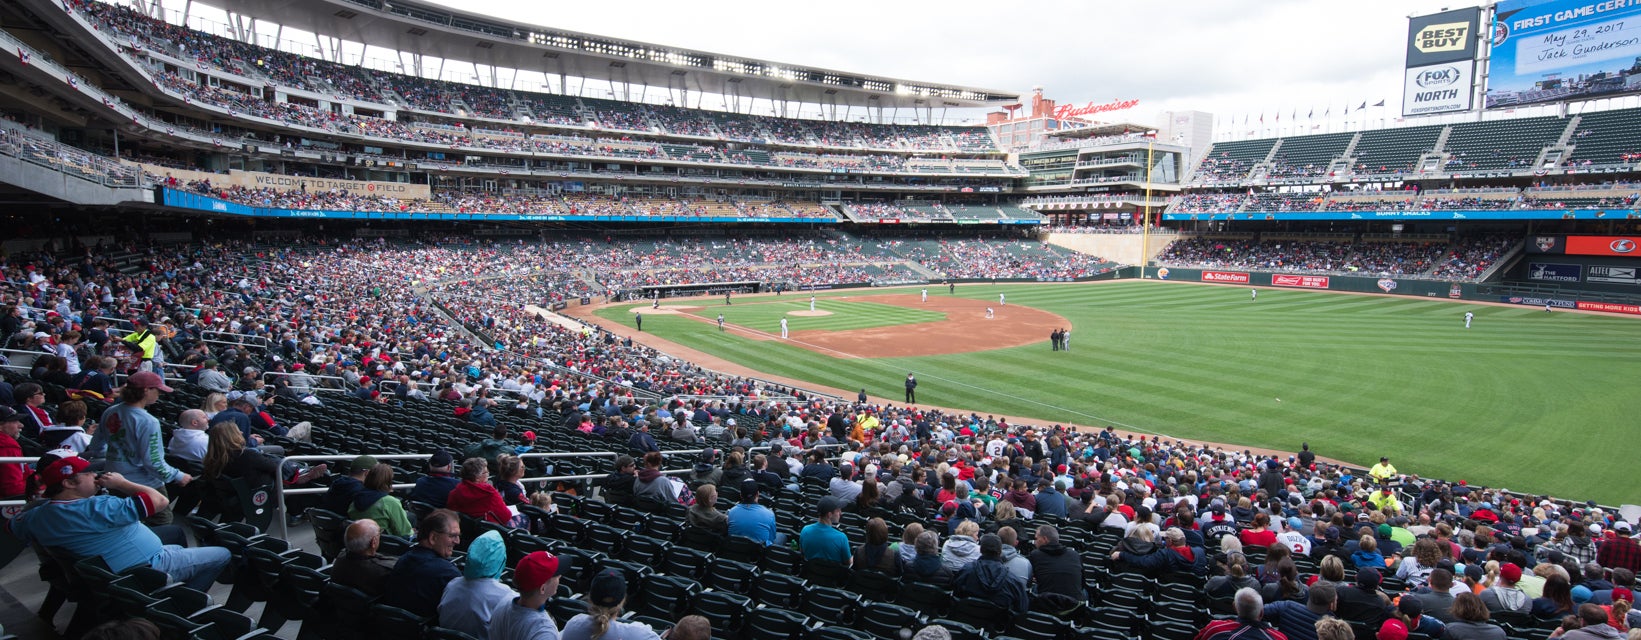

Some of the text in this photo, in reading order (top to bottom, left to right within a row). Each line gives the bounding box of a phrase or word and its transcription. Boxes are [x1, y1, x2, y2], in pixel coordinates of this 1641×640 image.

[1513, 13, 1552, 31] FIRST
[1554, 4, 1595, 20] GAME
[1422, 27, 1467, 39] BEST
[1544, 34, 1567, 47] May
[1595, 21, 1625, 34] 2017
[1422, 37, 1462, 48] BUY
[1538, 48, 1567, 61] Jack
[1572, 37, 1639, 56] Gunderson
[1424, 78, 1451, 86] SPORTS
[1425, 69, 1451, 82] FOX
[1414, 88, 1459, 103] NORTH
[1051, 98, 1140, 121] Budweiser
[255, 175, 406, 193] WELCOME TO TARGET FIELD
[1578, 302, 1603, 310] GETTING
[994, 446, 1001, 456] 2
[1293, 543, 1304, 553] 2
